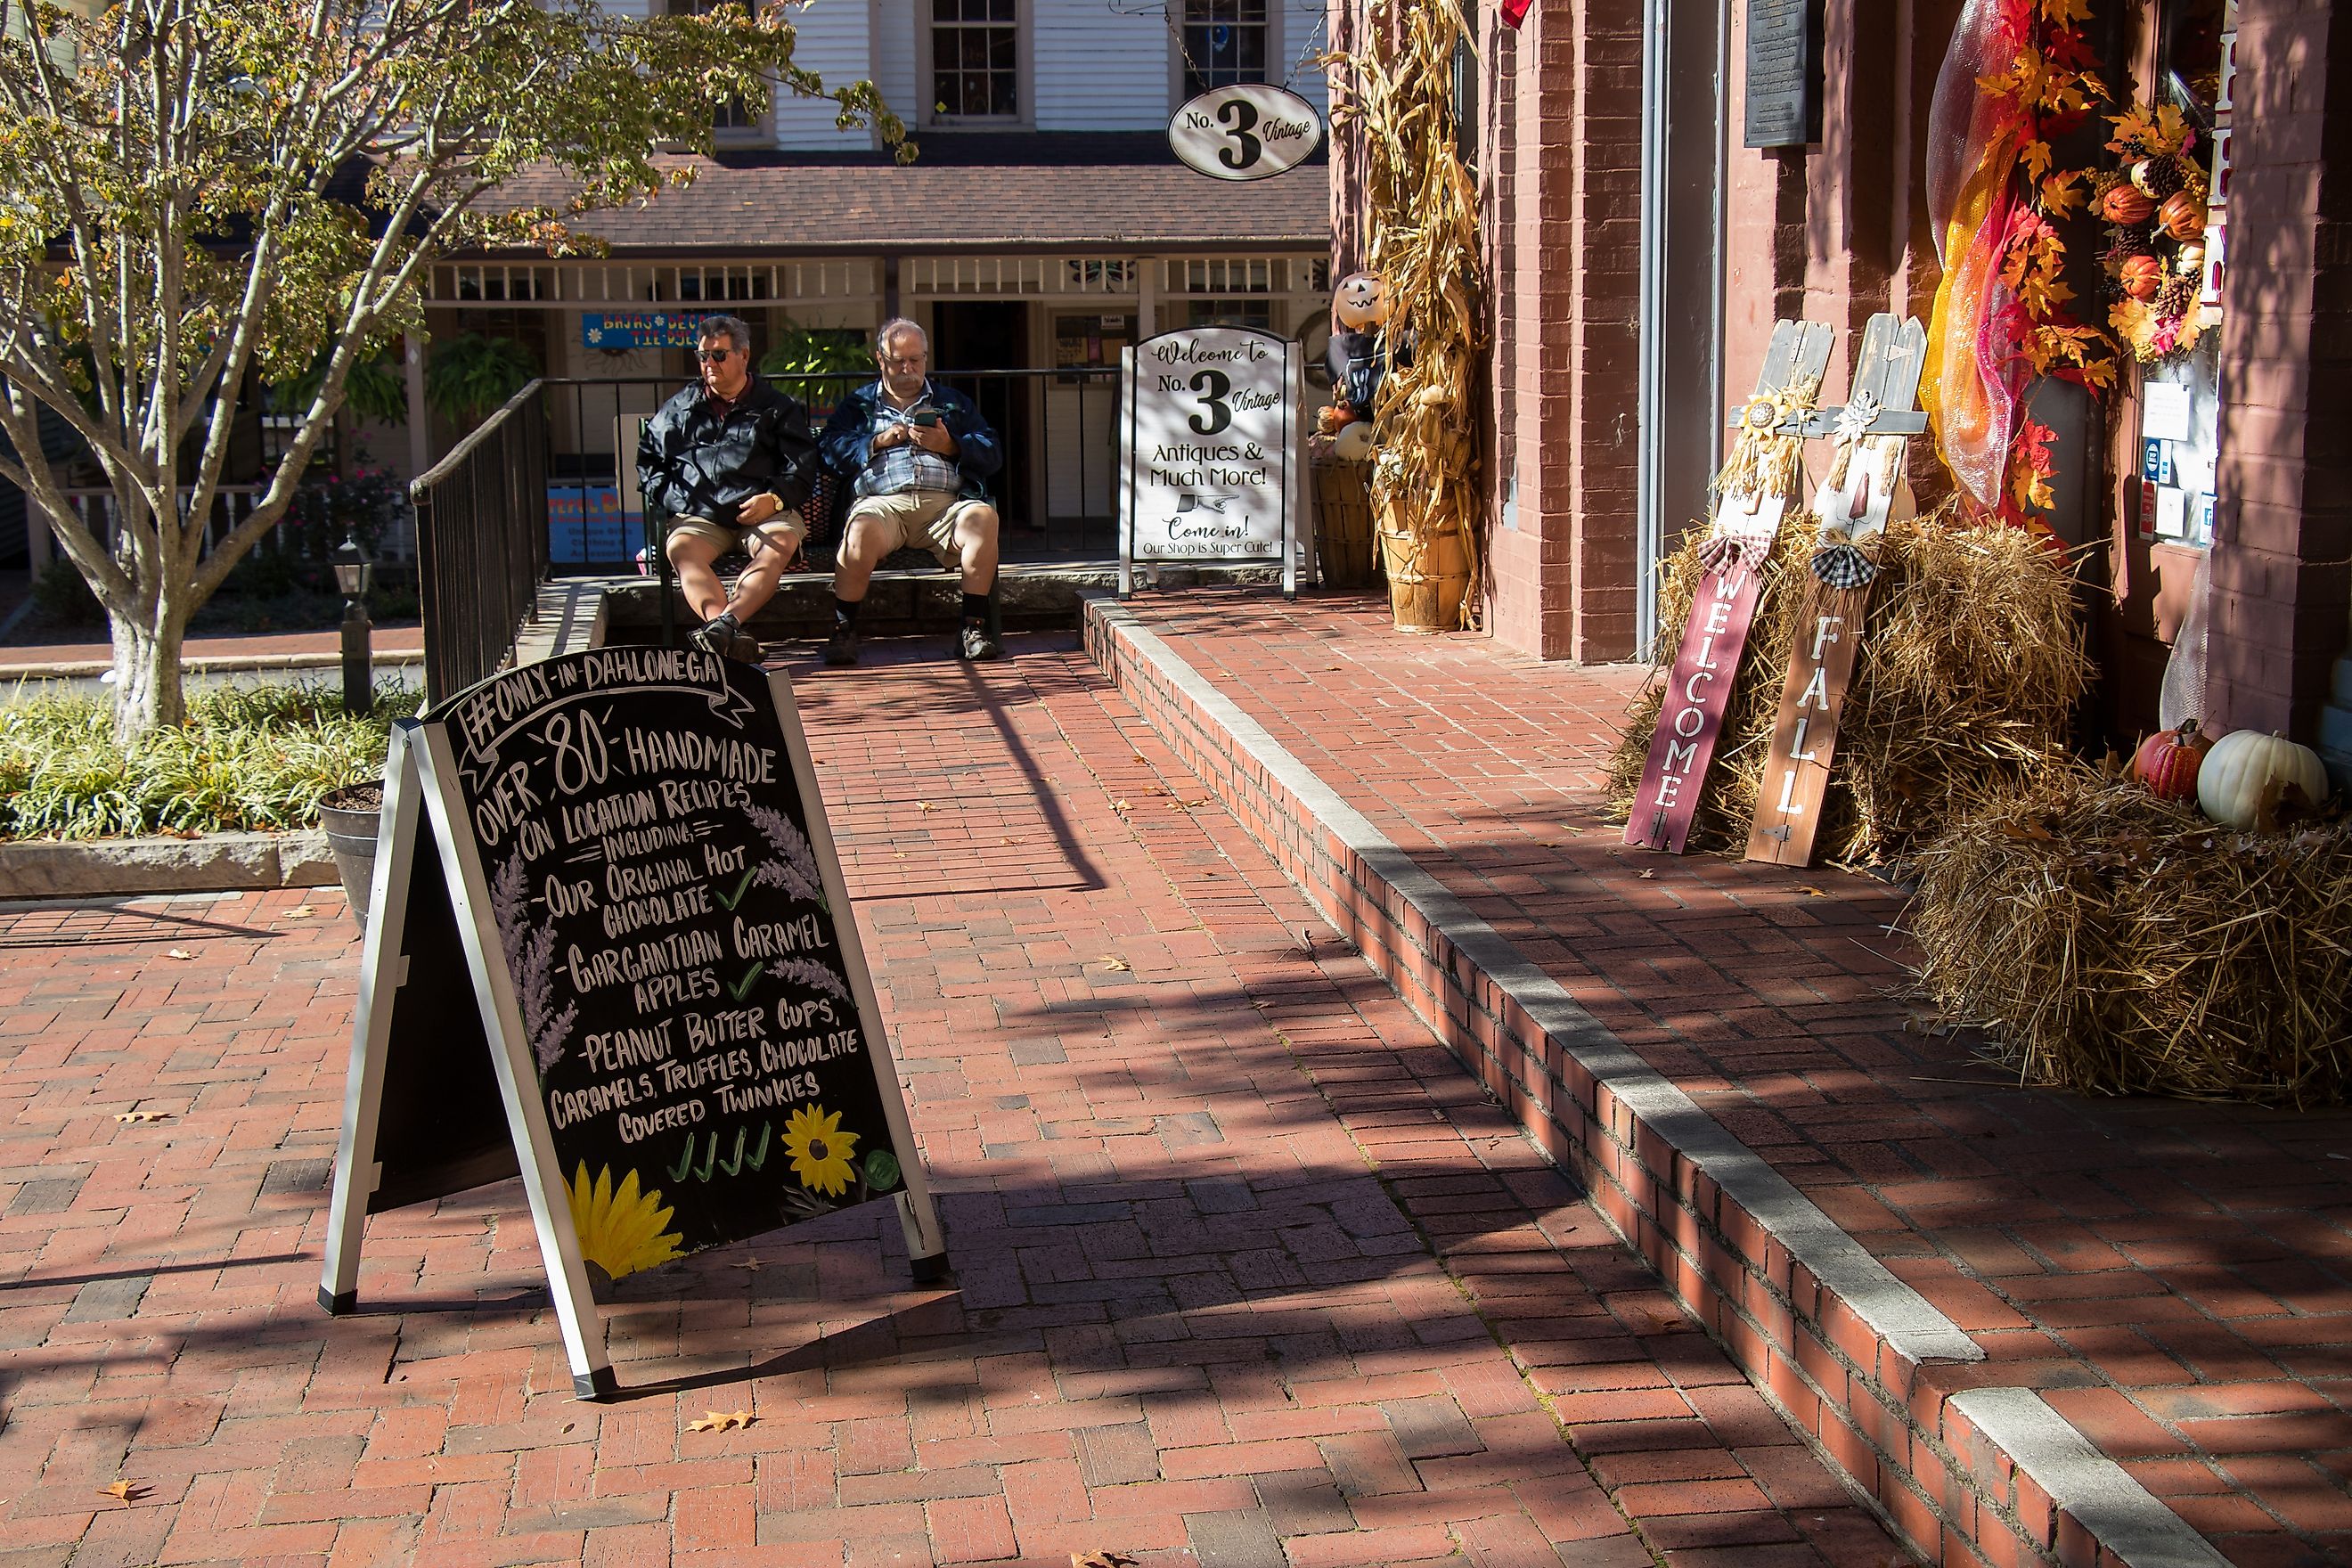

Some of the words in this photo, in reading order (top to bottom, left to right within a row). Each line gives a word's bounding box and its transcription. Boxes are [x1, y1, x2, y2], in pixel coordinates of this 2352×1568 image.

[1187, 112, 1213, 128] No.
[1217, 100, 1262, 169] 3
[1262, 118, 1311, 142] Vintage
[603, 314, 652, 329] BAJAS
[668, 314, 706, 330] DEC
[1151, 338, 1243, 364] Welcome
[1240, 340, 1268, 363] to
[1158, 375, 1186, 391] No.
[1188, 370, 1232, 436] 3
[1232, 388, 1281, 412] Vintage
[1150, 469, 1204, 486] Much
[1210, 468, 1266, 486] More!
[1153, 444, 1239, 465] Antiques
[1245, 442, 1264, 460] &
[1143, 543, 1164, 554] Our
[1167, 542, 1195, 556] Shop
[1198, 543, 1207, 553] is
[1210, 543, 1242, 556] Super
[1245, 542, 1272, 553] Cute!
[1162, 517, 1219, 540] Come
[1224, 515, 1249, 539] in!
[467, 650, 719, 746] #ONLY-IN-DAHLONEGA
[1654, 570, 1747, 807] WELCOME
[1776, 616, 1845, 815] FALL
[477, 762, 542, 845] OVER
[546, 709, 608, 795] 80
[625, 727, 777, 784] HANDMADE
[519, 817, 555, 861] ON
[562, 789, 657, 844] LOCATION
[659, 780, 750, 819] RECIPES
[601, 821, 695, 863] INCLUDING
[607, 857, 703, 902] ORIGINAL
[704, 844, 746, 877] HOT
[603, 885, 714, 939] CHOCOLATE
[733, 913, 829, 960] CARAMEL
[634, 968, 720, 1014] APPLES
[682, 1007, 766, 1053] BUTTER
[778, 998, 840, 1026] CUPS,
[551, 1074, 657, 1130] CARAMELS,
[656, 1049, 759, 1093] TRUFFLES,
[760, 1029, 858, 1074] CHOCOLATE
[618, 1099, 706, 1144] COVERED
[713, 1072, 821, 1115] TWINKIES
